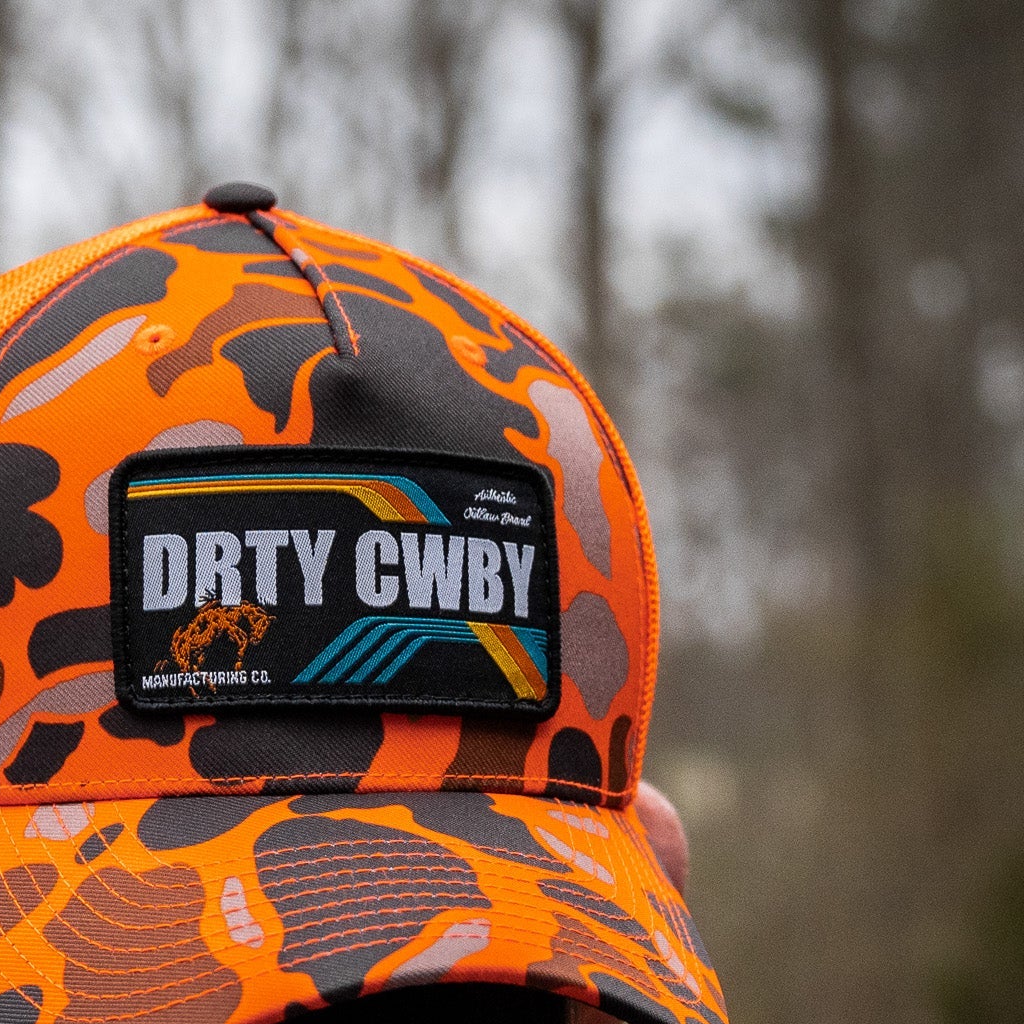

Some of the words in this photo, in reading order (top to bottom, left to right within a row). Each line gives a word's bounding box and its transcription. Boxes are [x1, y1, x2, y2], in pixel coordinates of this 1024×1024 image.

[474, 488, 517, 505] Authentic
[463, 506, 500, 522] Outlaw
[500, 511, 532, 527] Brand
[142, 529, 336, 611] DRTY
[355, 529, 535, 618] CWBY
[141, 670, 247, 689] MANUFACTURING
[250, 670, 272, 684] CO.
